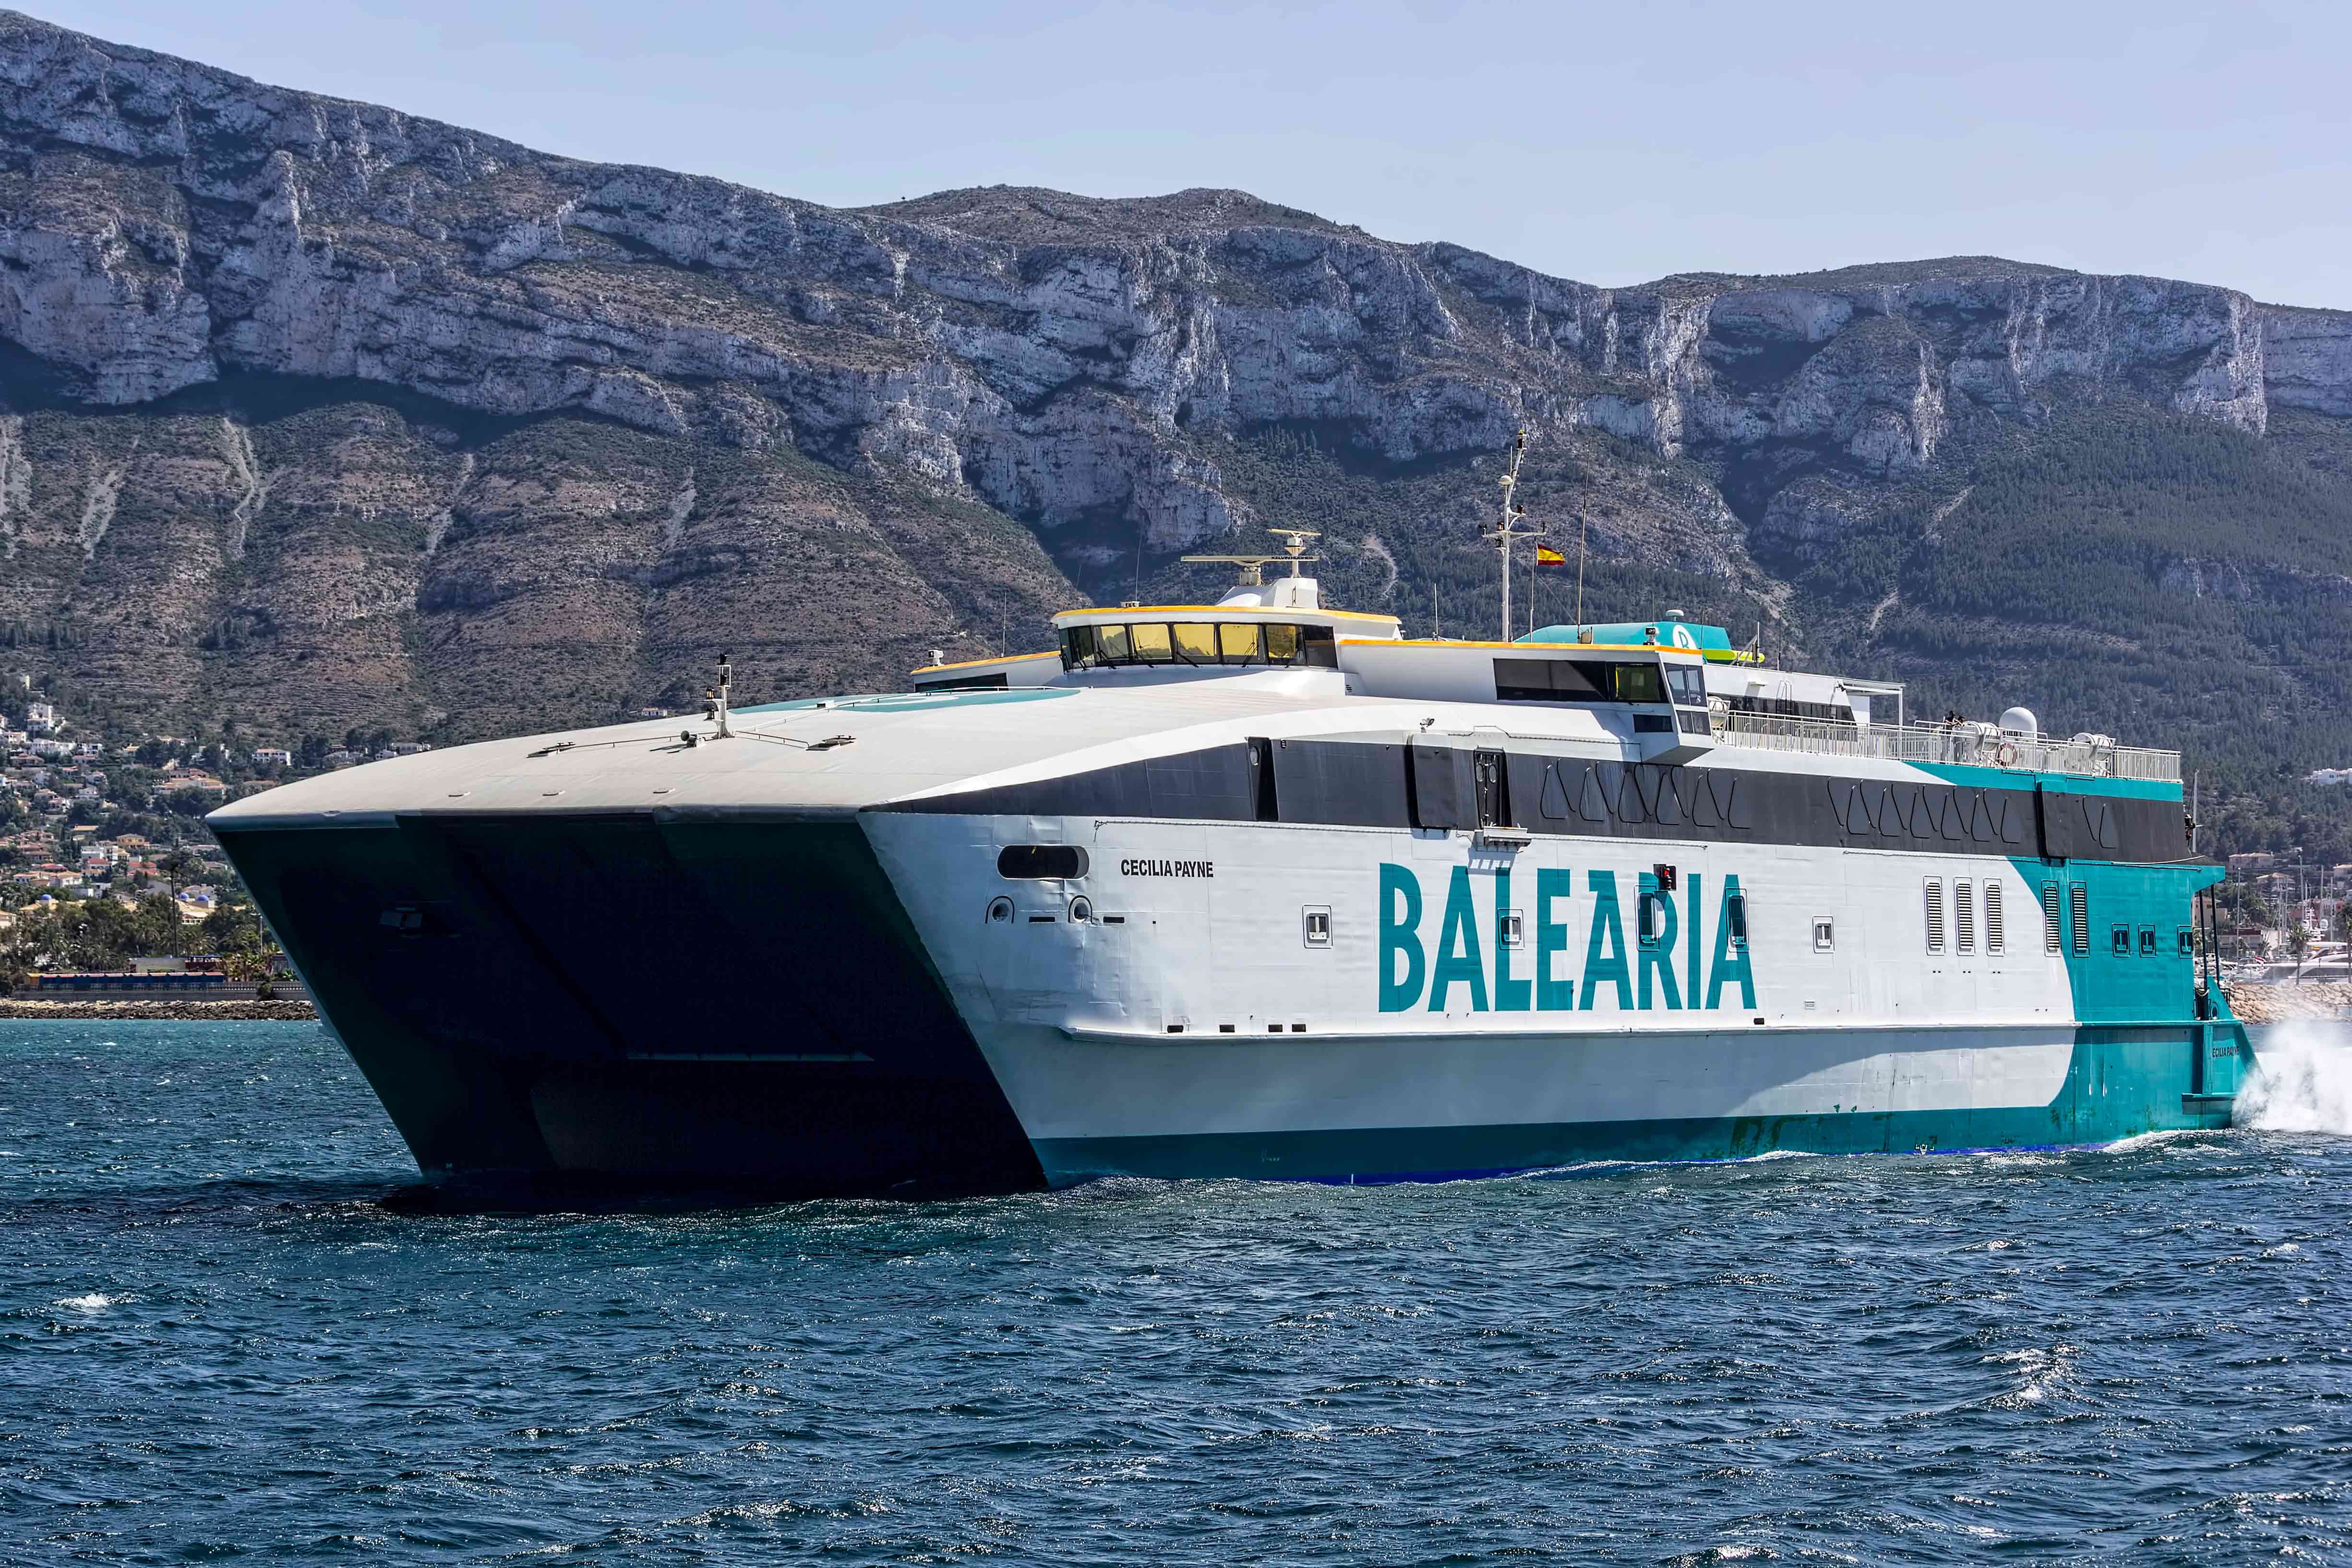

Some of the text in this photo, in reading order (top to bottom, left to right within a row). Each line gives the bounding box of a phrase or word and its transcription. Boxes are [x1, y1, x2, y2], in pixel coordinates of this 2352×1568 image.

[1121, 859, 1214, 877] CECILIA PAYNE
[2212, 1047, 2226, 1057] ECILIA
